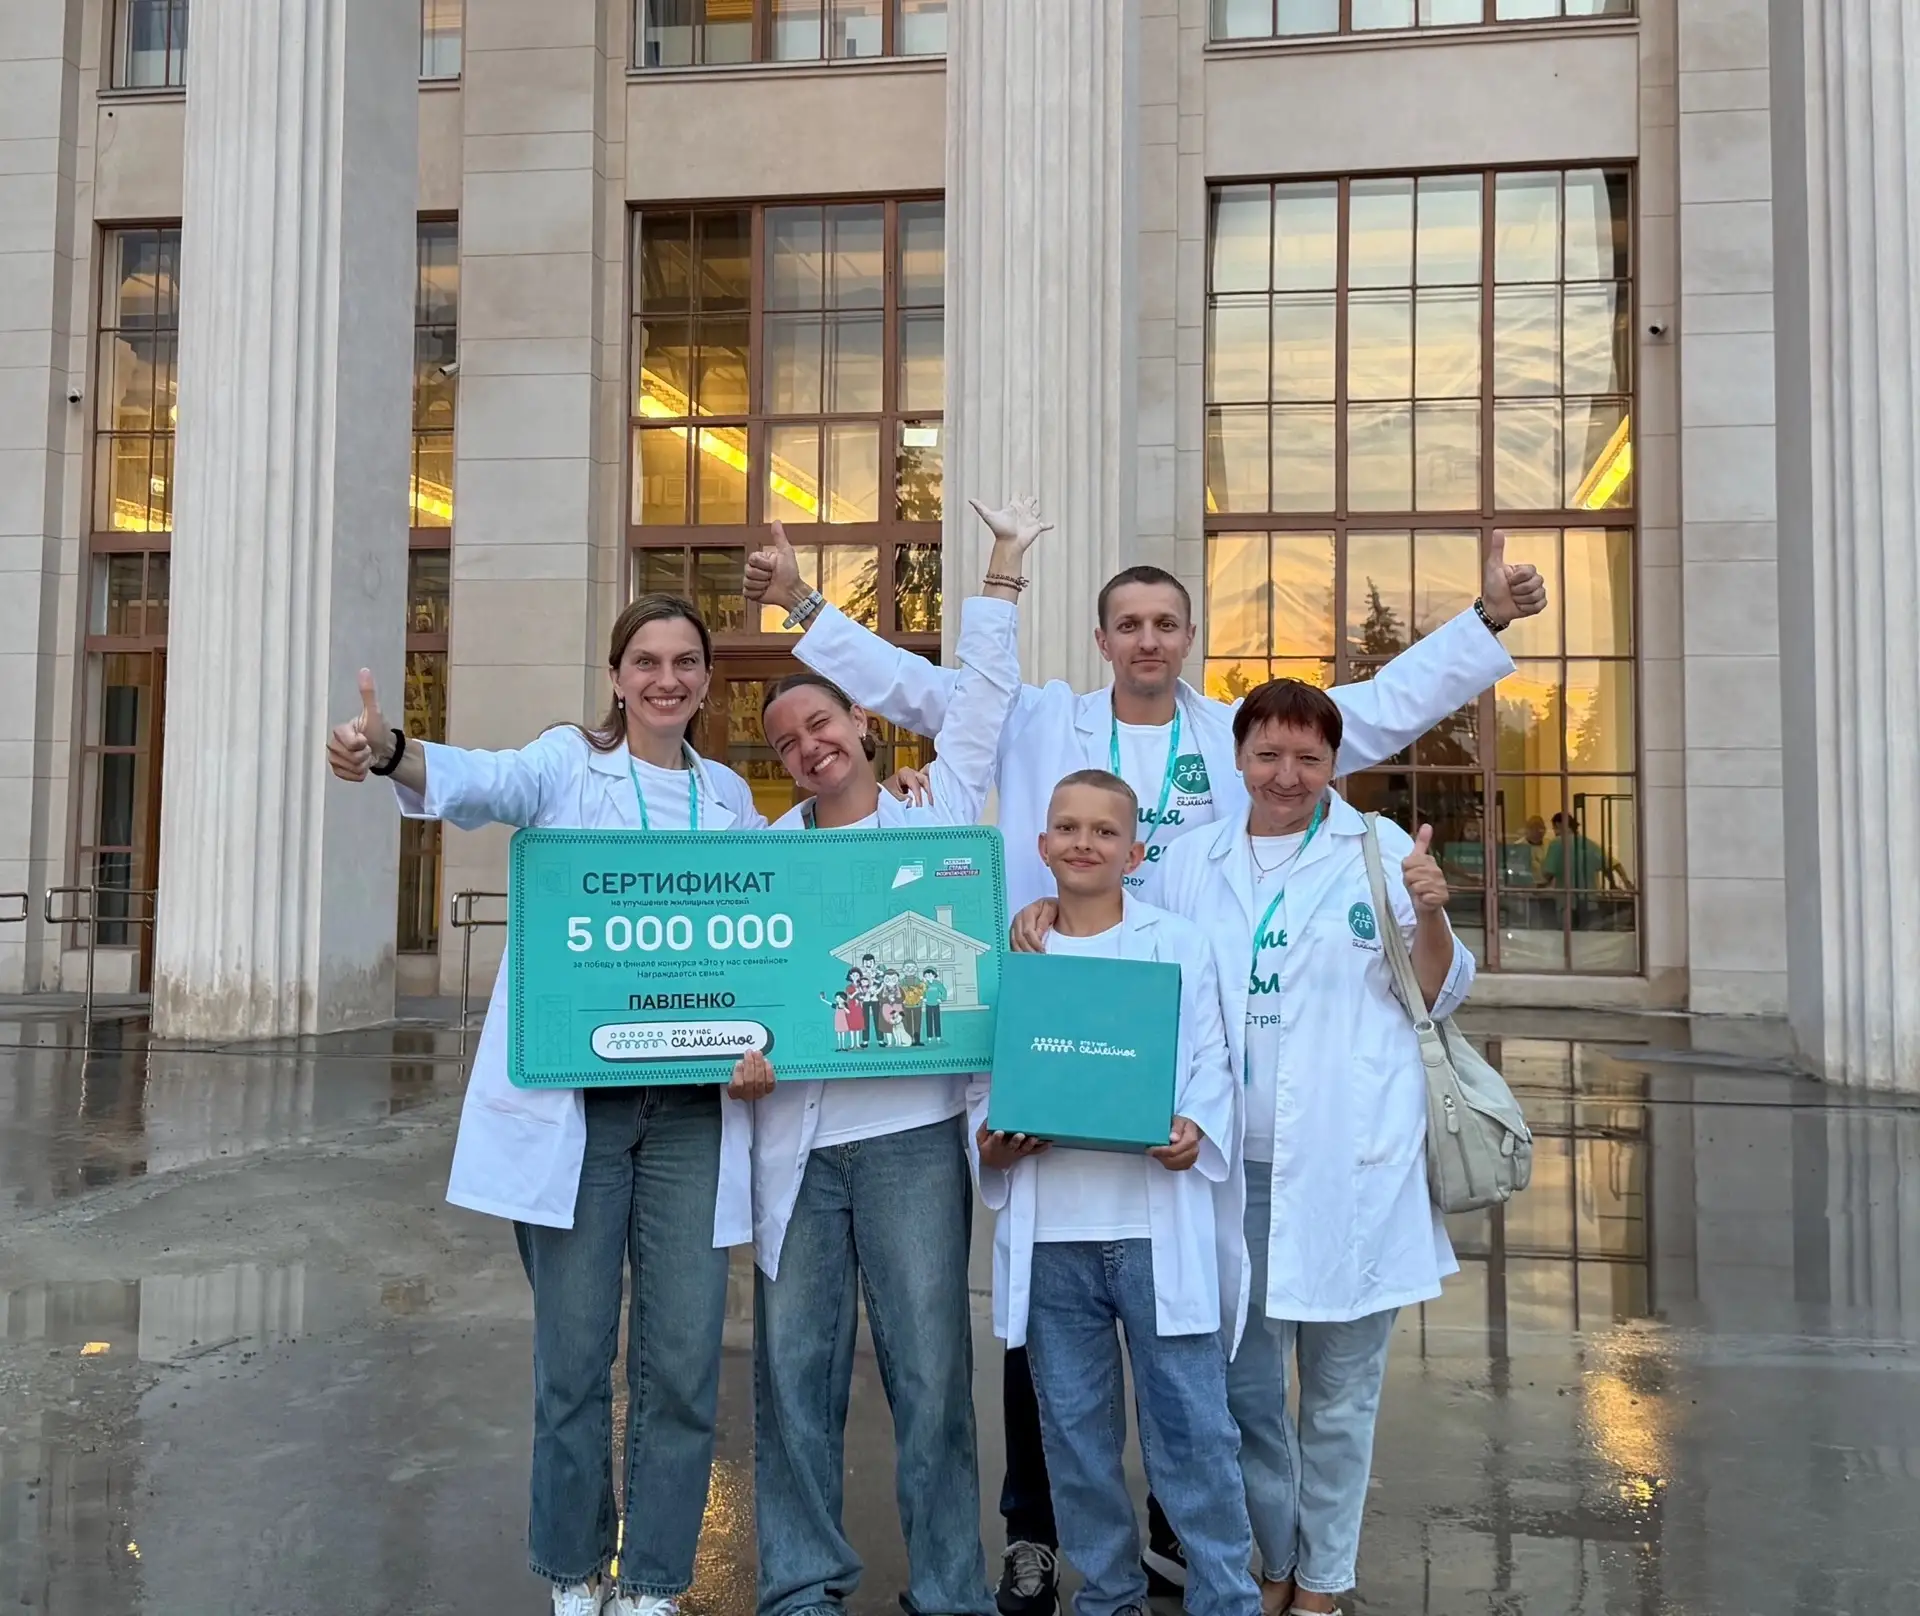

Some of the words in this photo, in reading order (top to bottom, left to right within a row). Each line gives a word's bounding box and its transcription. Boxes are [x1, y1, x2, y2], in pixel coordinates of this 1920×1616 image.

[582, 870, 776, 896] СЕРТИФИКАТ
[623, 900, 669, 908] улучшение
[670, 899, 715, 907] жилищных
[716, 897, 750, 906] условий
[567, 916, 593, 951] 5
[605, 915, 693, 951] 000
[707, 913, 794, 950] 000
[584, 960, 615, 969] победу
[623, 960, 656, 968] финале
[657, 960, 697, 968] конкурса
[719, 959, 725, 967] у
[637, 970, 698, 979] Награждается
[629, 992, 736, 1010] ПАВЛЕНКО
[689, 1029, 694, 1037] у
[671, 1032, 755, 1048] семейное
[1079, 1045, 1136, 1057] семейное
